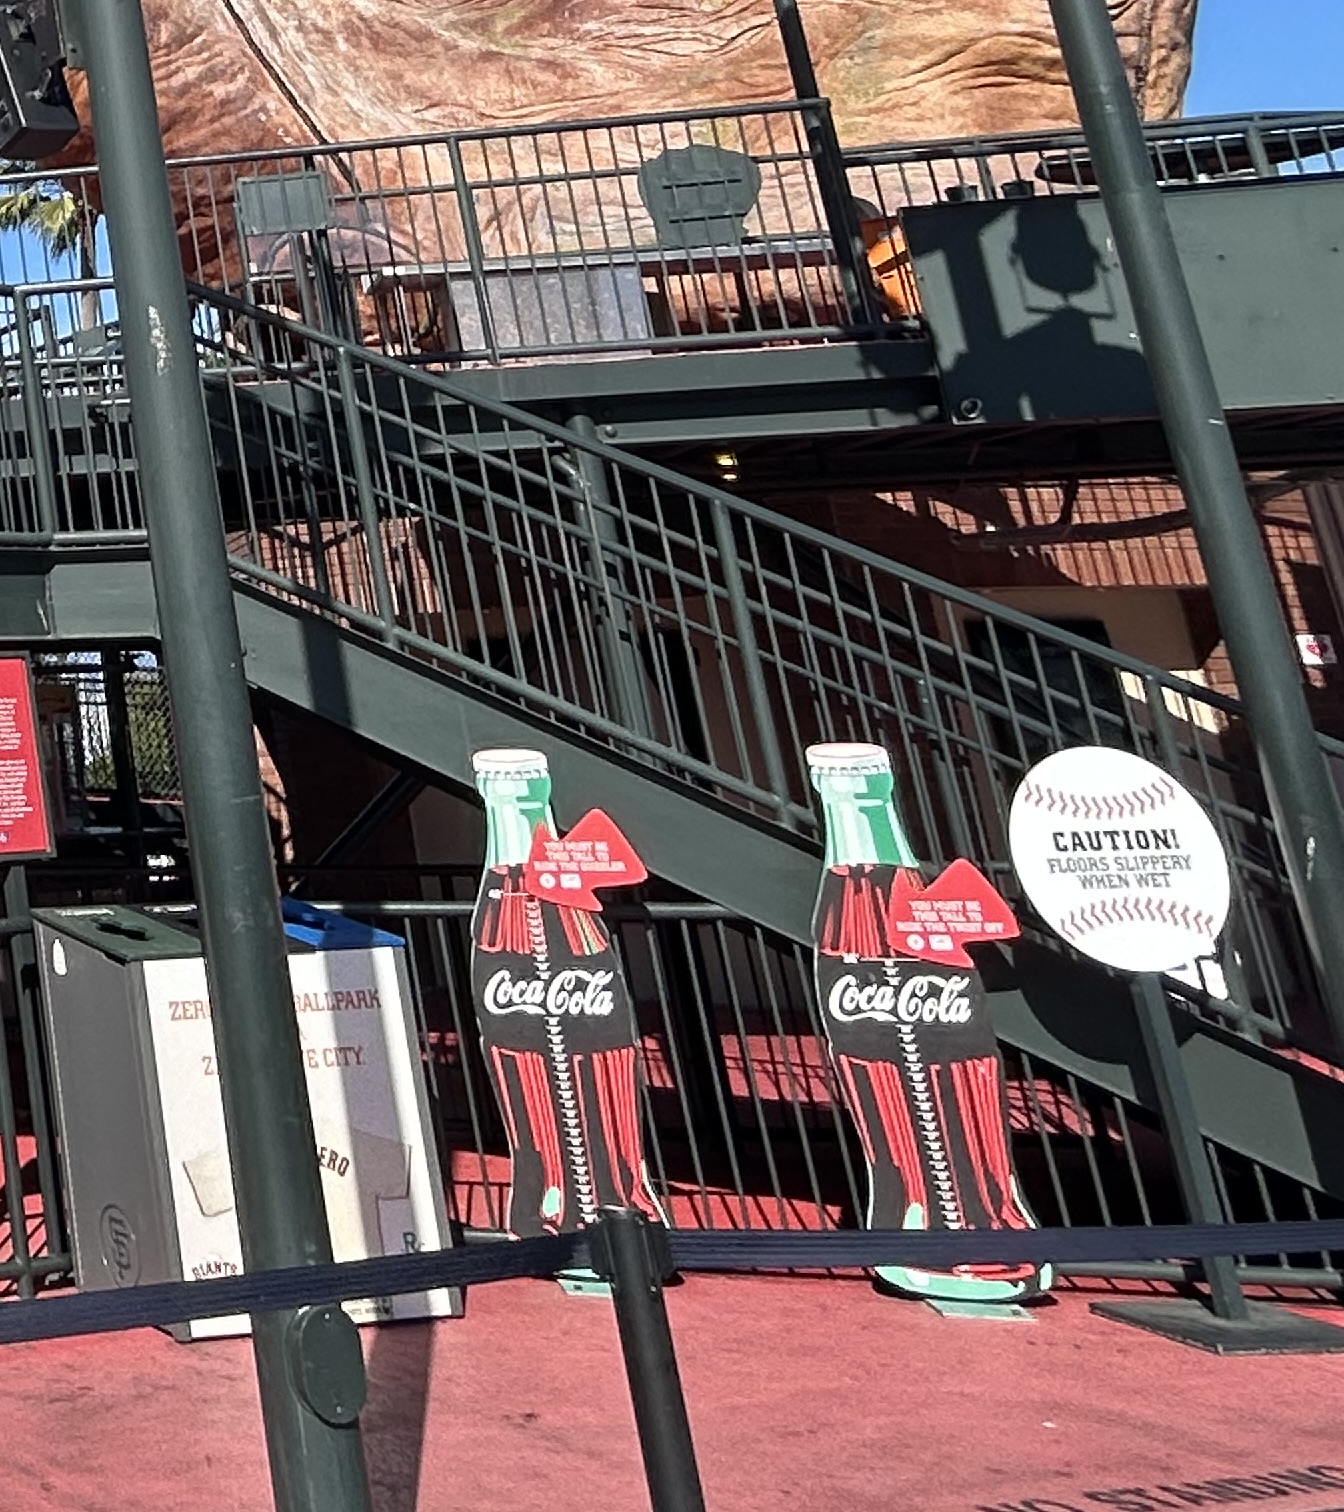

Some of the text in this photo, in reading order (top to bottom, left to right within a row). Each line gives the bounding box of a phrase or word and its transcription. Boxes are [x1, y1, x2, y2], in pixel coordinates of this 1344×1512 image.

[1052, 828, 1181, 852] CAUTION!
[1047, 854, 1192, 874] FLOORS SLIPPERY
[1079, 872, 1172, 890] WHEN WET
[318, 1146, 350, 1178] ERO
